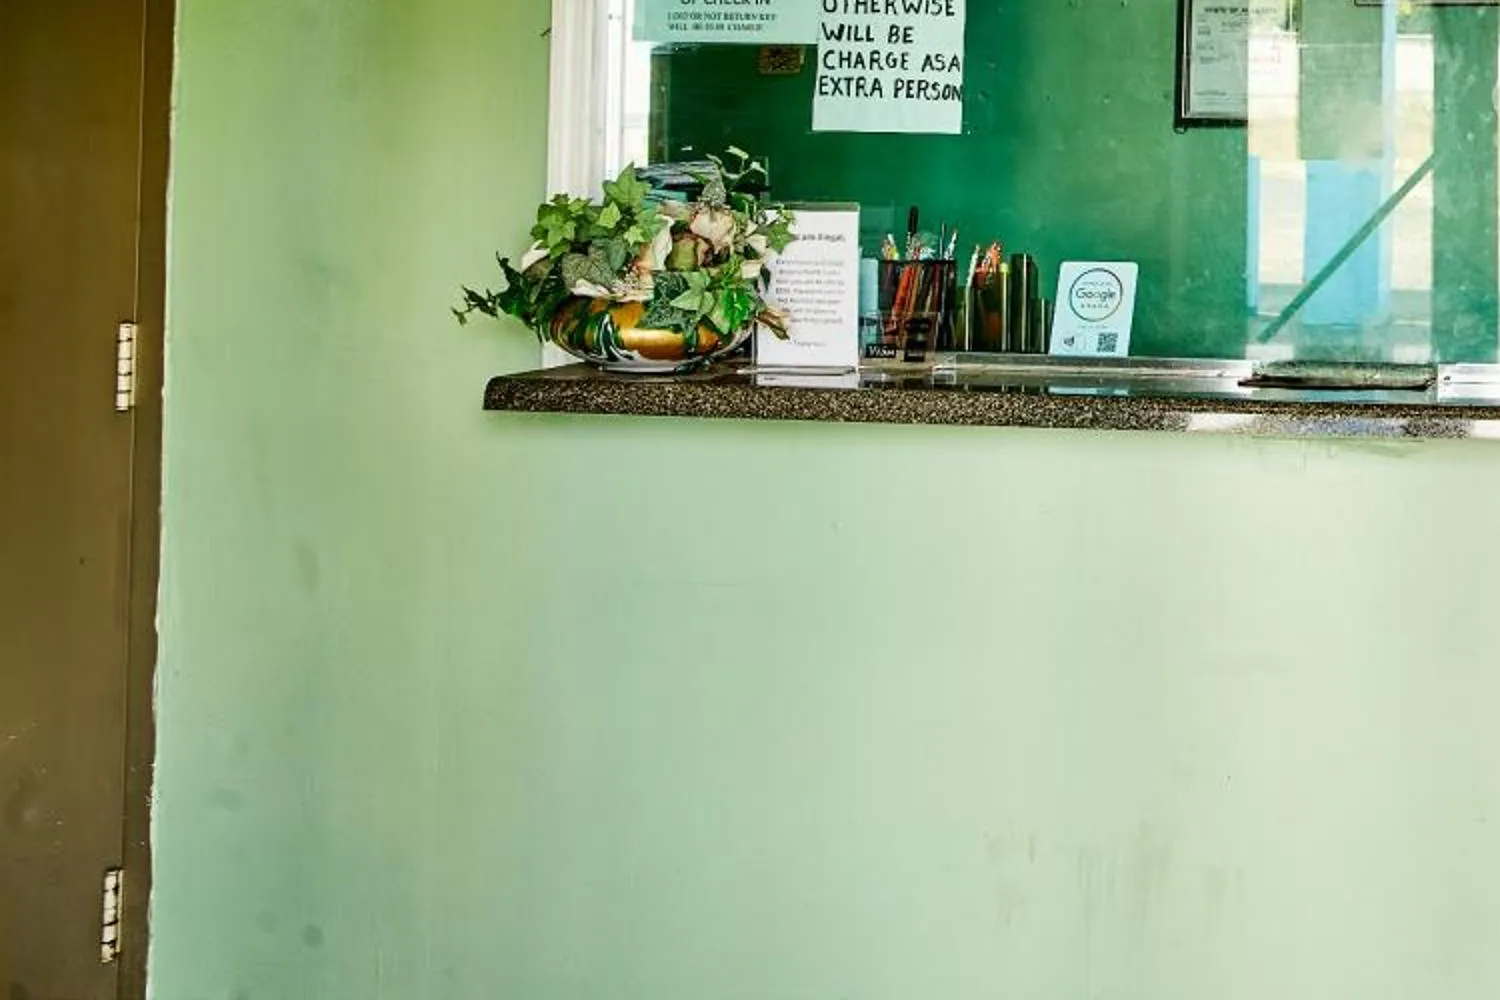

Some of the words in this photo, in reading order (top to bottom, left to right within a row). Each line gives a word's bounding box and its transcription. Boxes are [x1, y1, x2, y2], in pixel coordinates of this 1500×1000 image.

[821, 22, 875, 42] WILL
[888, 23, 914, 44] BE
[823, 49, 909, 71] CHARGE
[819, 75, 883, 99] EXTRA
[893, 77, 963, 101] PERSON
[1075, 287, 1117, 302] Google
